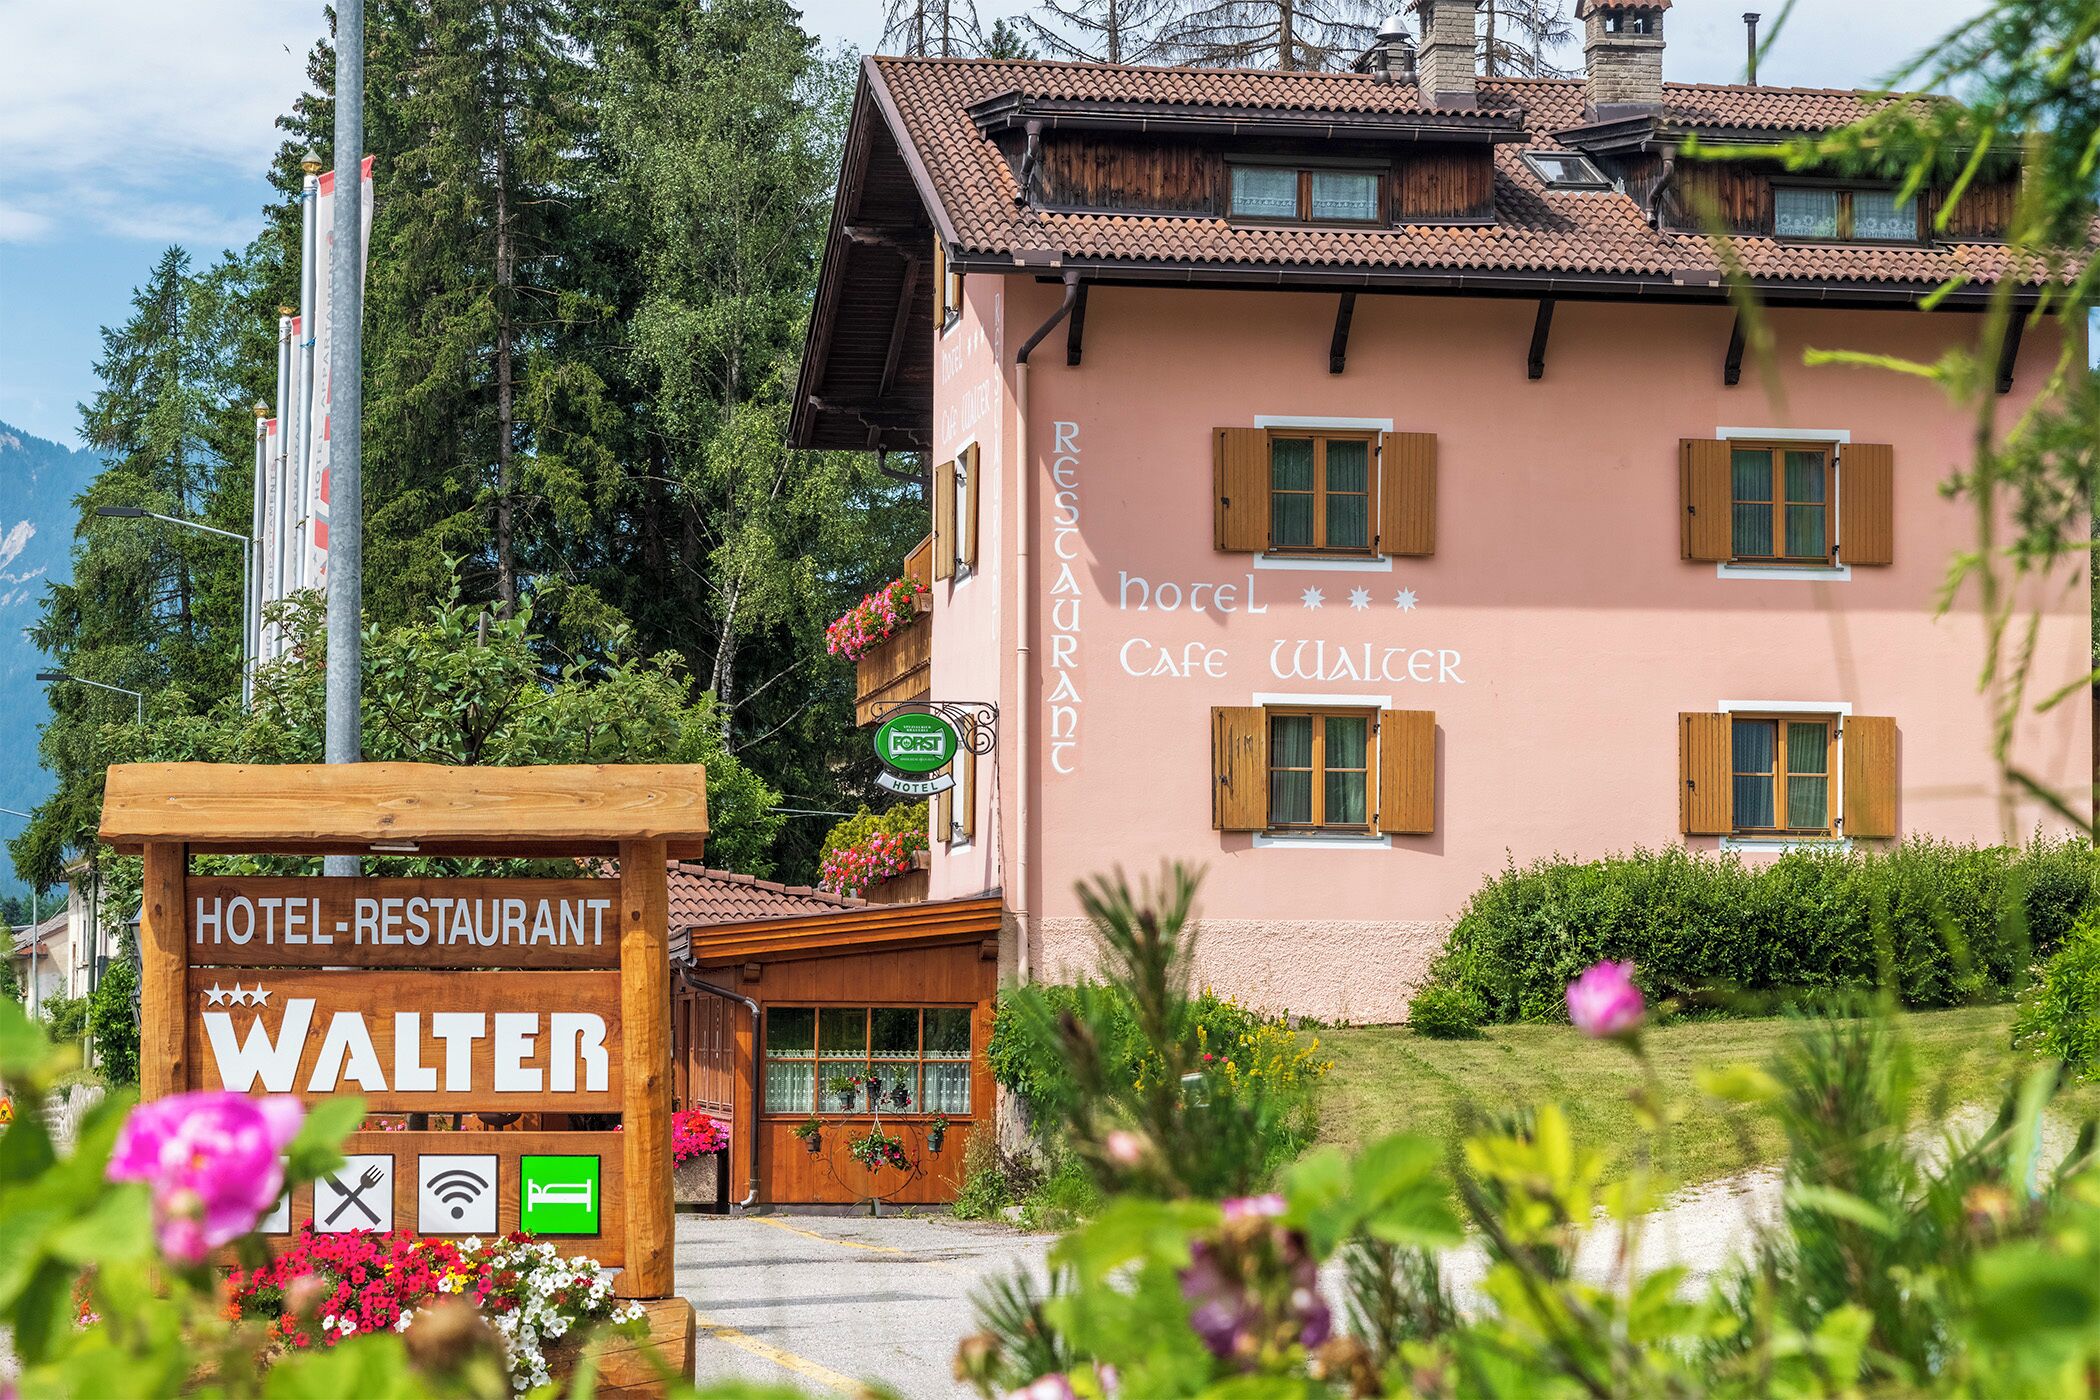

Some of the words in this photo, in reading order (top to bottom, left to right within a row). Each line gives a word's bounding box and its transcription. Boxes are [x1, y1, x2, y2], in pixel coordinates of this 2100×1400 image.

[314, 426, 323, 500] HOTEL
[1047, 421, 1082, 774] RESTAURANT
[1118, 570, 1268, 614] HOTEL
[1270, 639, 1466, 684] WALTER
[893, 736, 941, 751] FORST
[893, 781, 938, 792] HOTEL
[196, 896, 610, 947] HOTEL-RESTAURANT
[202, 998, 609, 1093] WALTER
